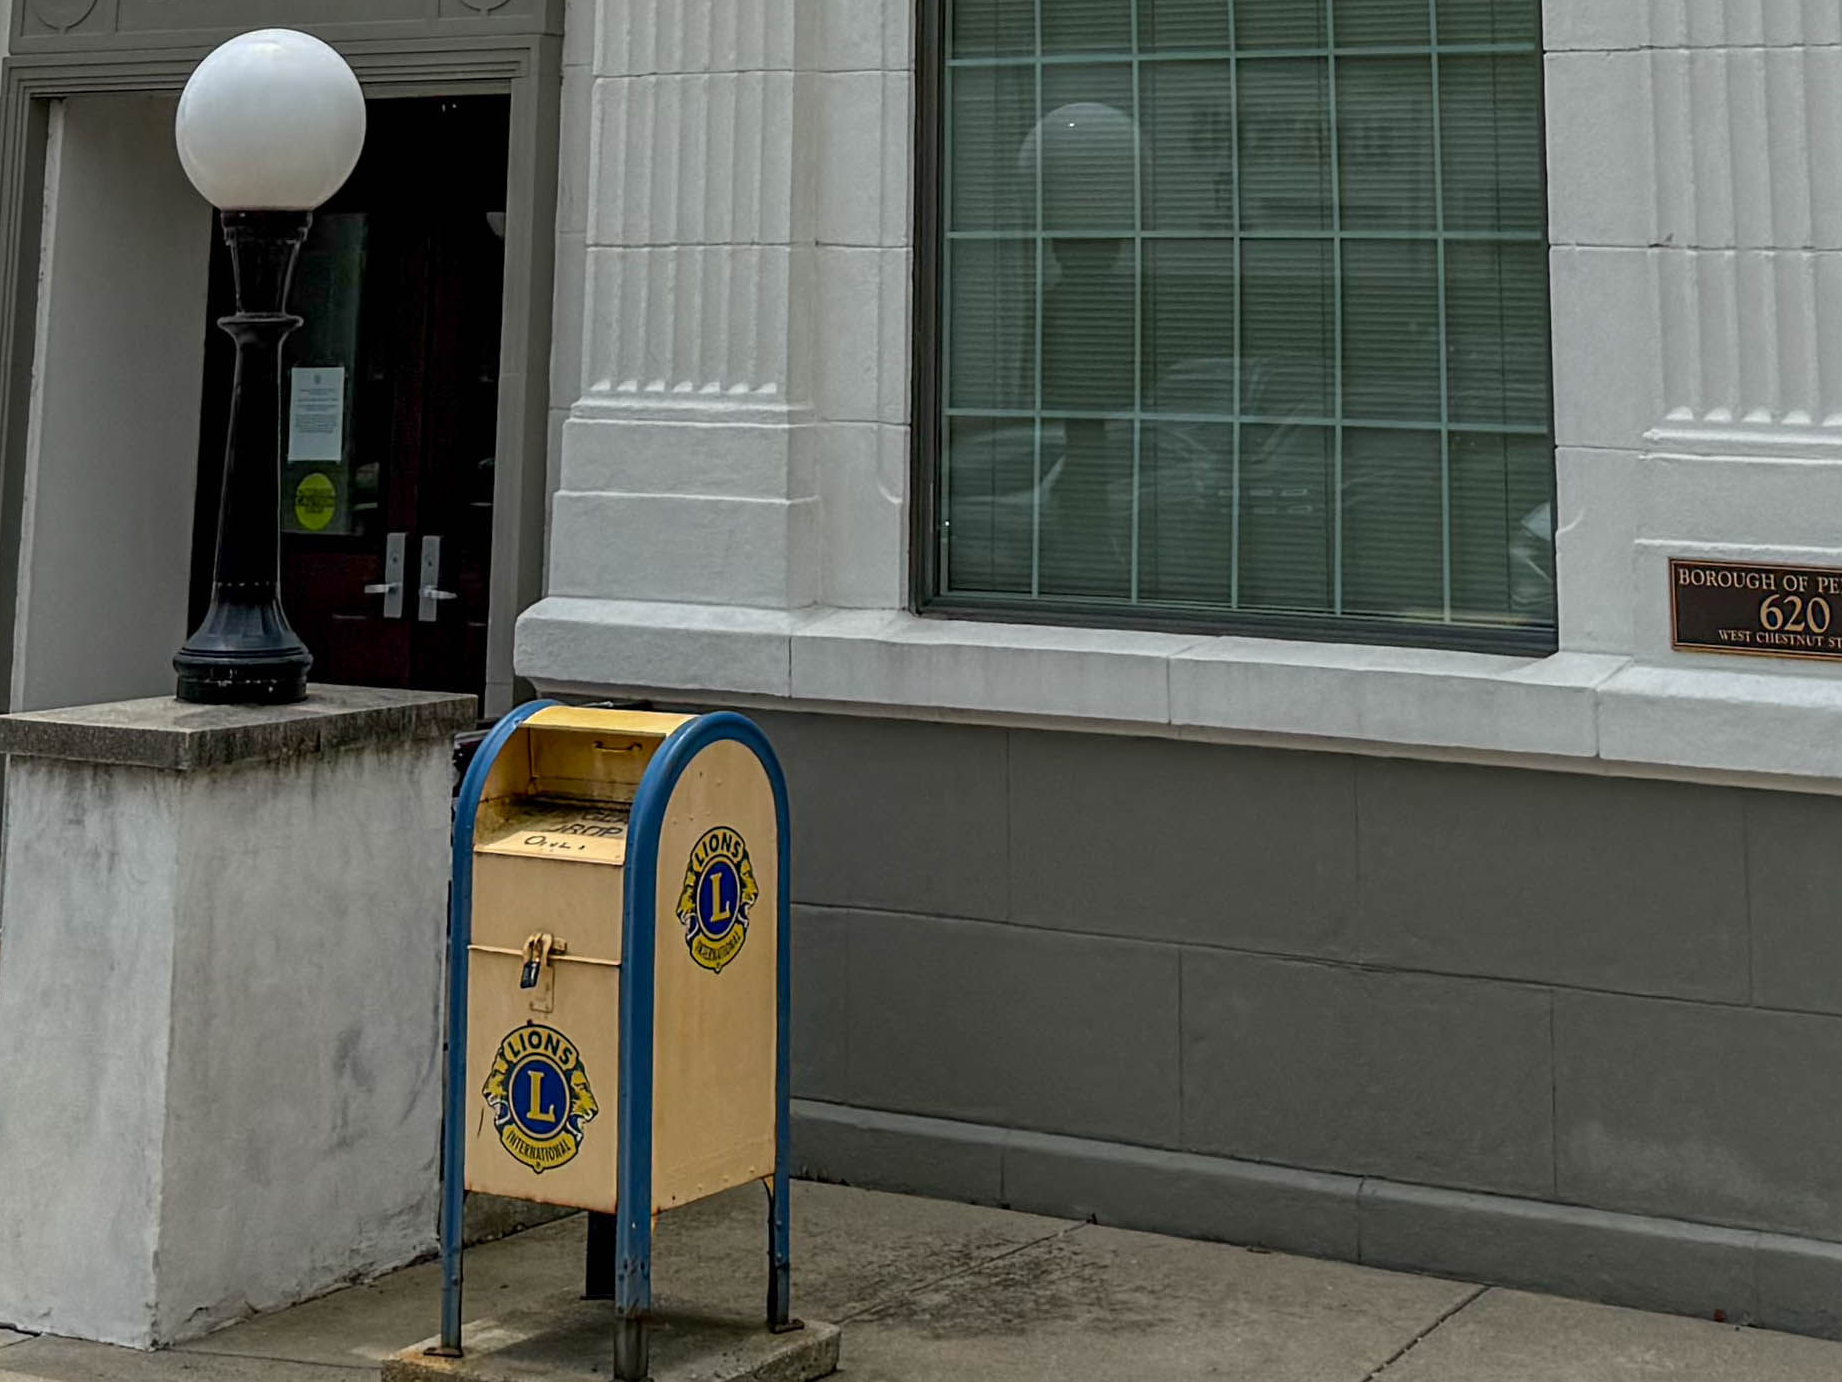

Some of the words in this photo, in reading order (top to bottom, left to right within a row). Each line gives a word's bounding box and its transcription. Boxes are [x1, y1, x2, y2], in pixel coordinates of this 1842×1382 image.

[1678, 568, 1775, 591] BOROUGH
[1782, 573, 1808, 592] OF
[1760, 593, 1831, 634] 620
[1718, 629, 1752, 643] WEST
[1756, 632, 1824, 648] CHESTNUT
[694, 832, 742, 868] LIONS
[709, 871, 731, 923] L
[508, 1030, 573, 1066] LIONS
[525, 1070, 556, 1123] L
[505, 1130, 572, 1163] INTERNATIONAL
